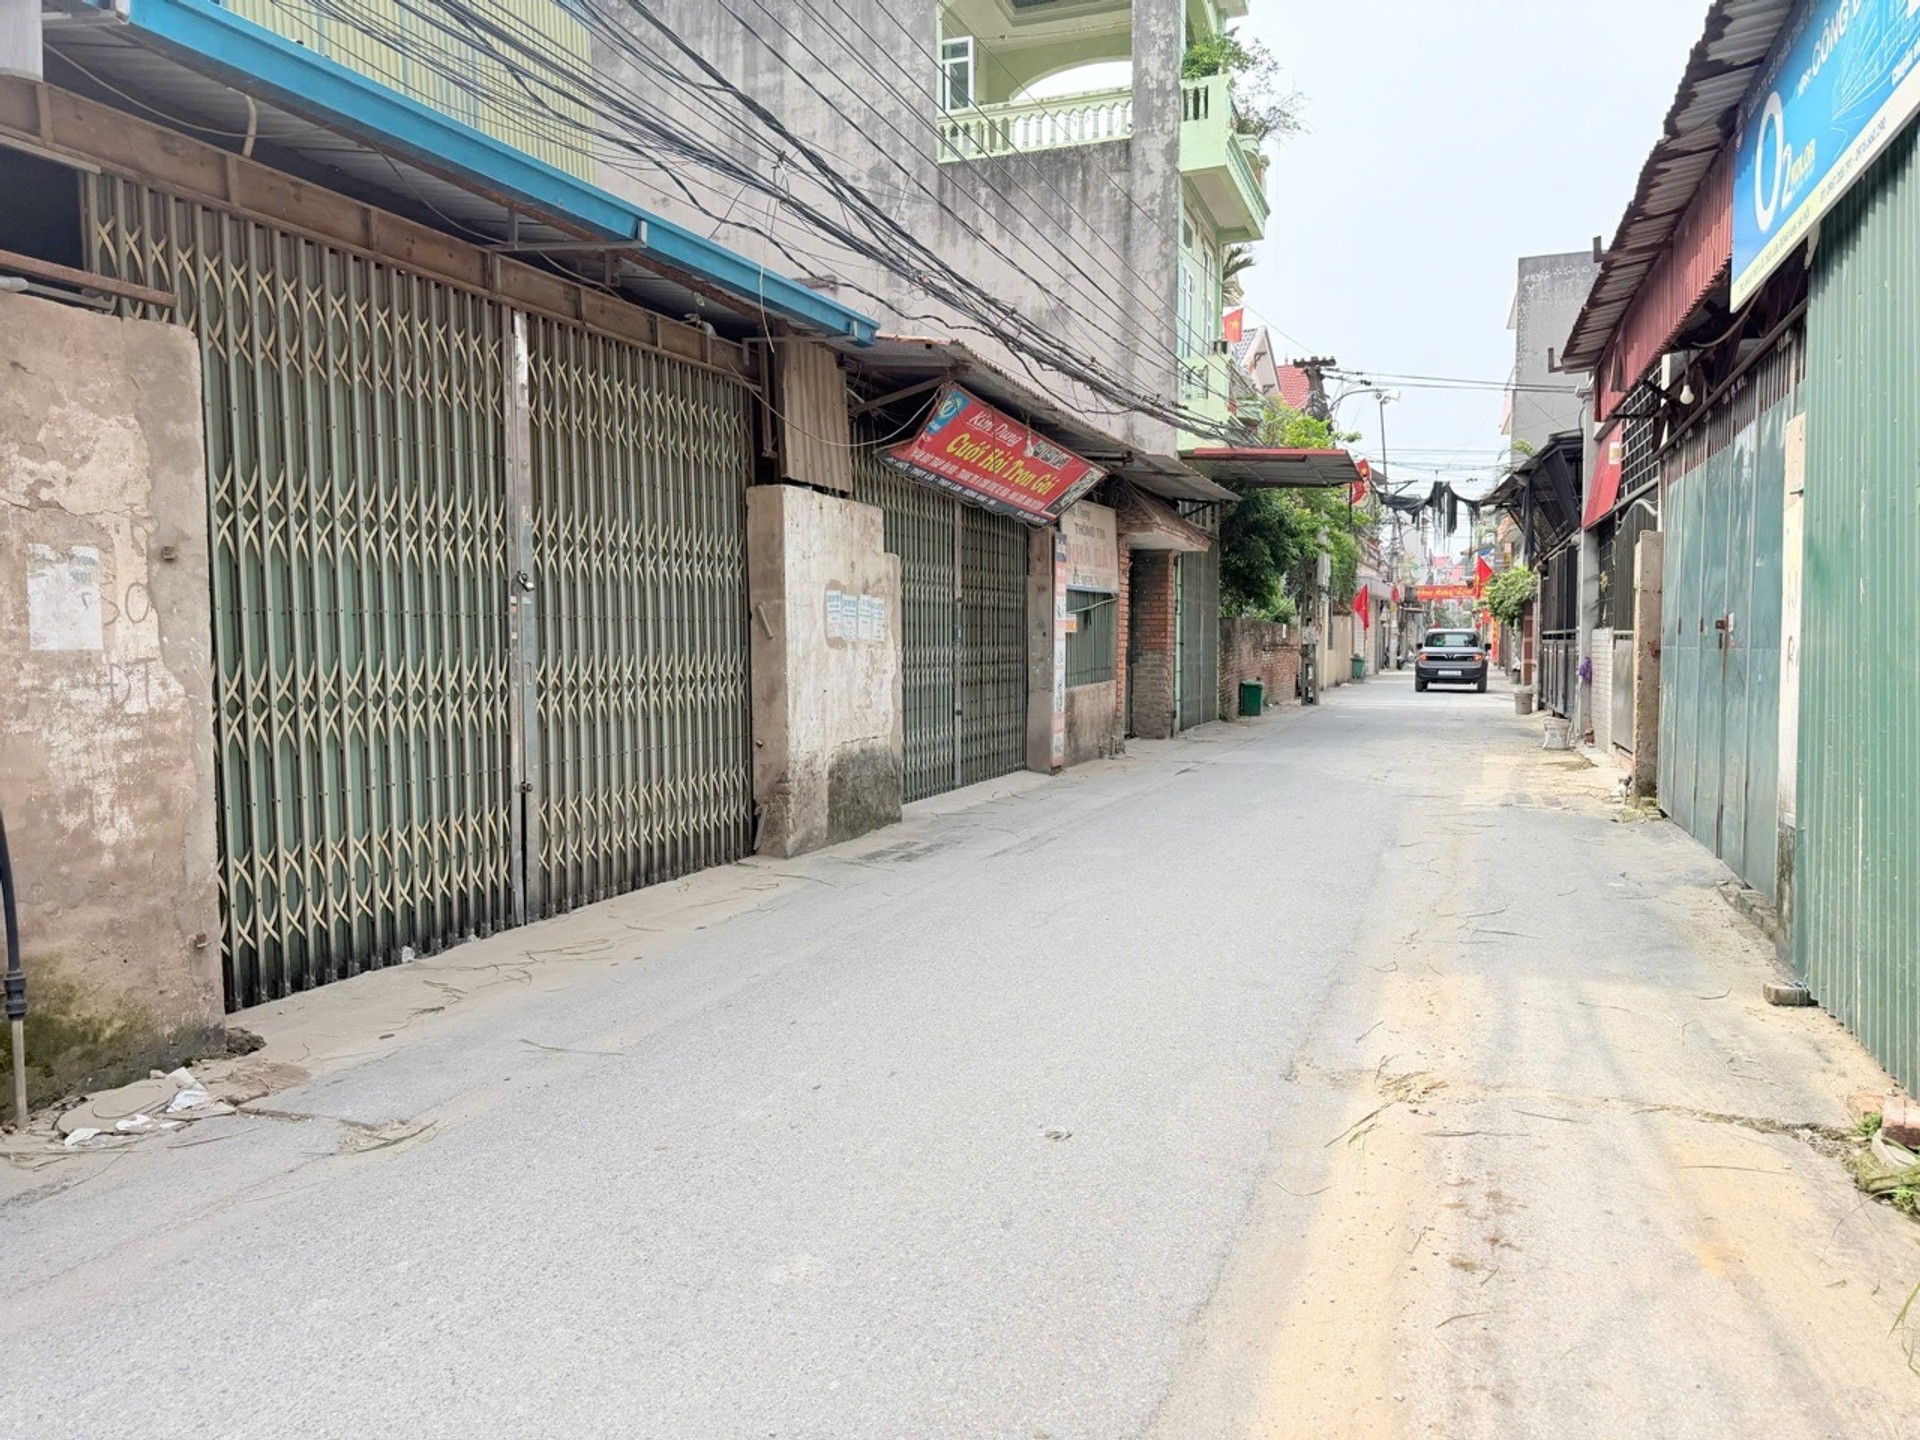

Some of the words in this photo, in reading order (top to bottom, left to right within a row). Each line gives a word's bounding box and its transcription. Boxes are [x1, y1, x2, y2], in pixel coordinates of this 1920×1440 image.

[946, 433, 991, 463] Cưới
[978, 448, 1014, 474] Hỏi
[1002, 459, 1037, 487] Trọn
[1031, 474, 1060, 496] Gói
